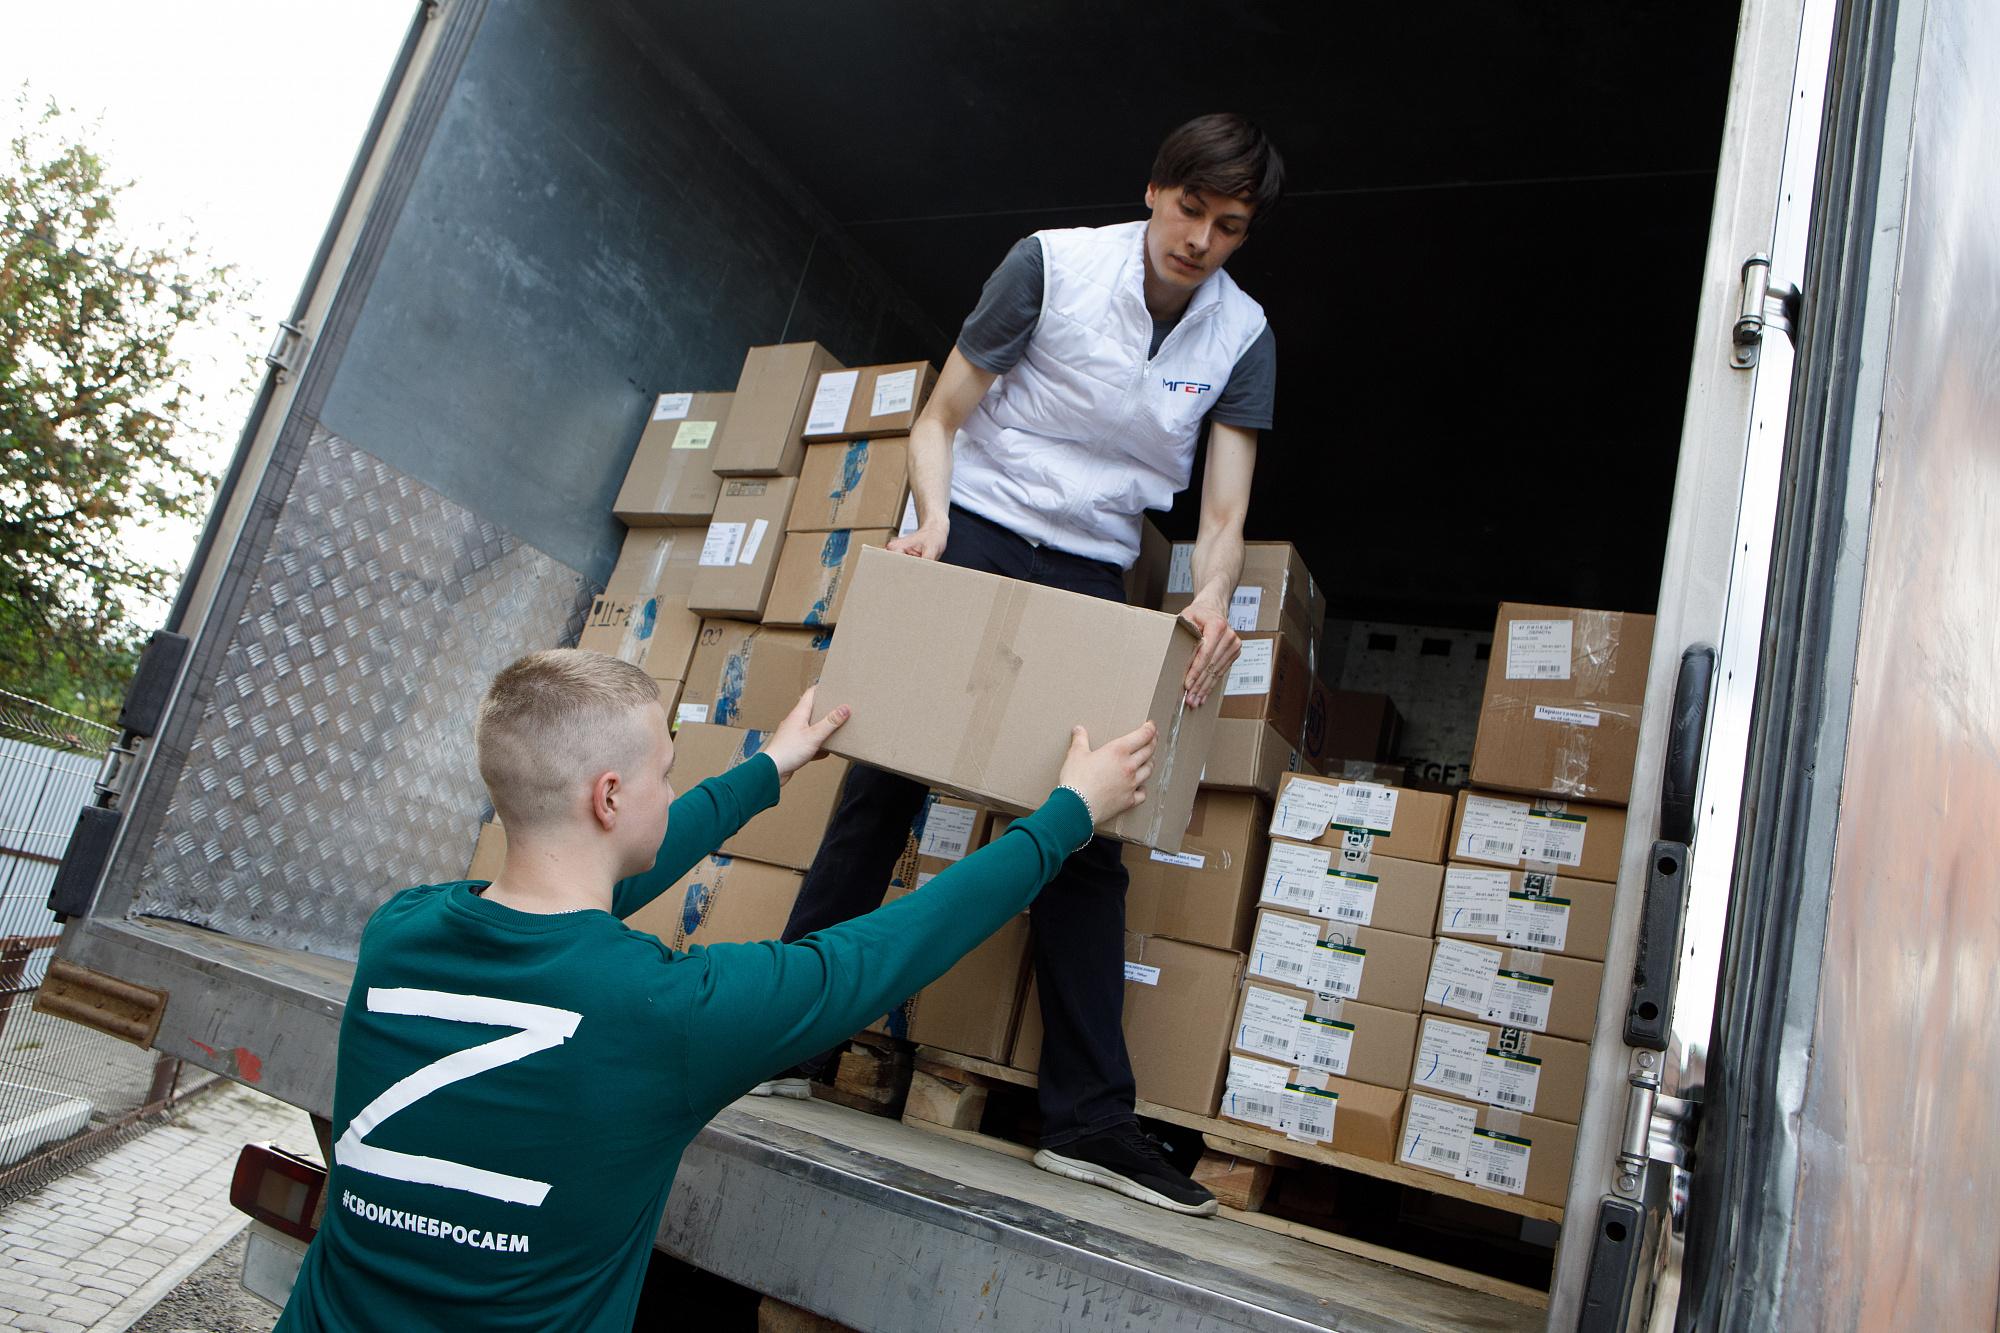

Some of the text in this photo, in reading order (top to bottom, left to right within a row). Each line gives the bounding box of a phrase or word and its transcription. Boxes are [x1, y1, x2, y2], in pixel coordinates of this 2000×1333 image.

[1162, 377, 1211, 394] МГЕР
[334, 987, 584, 1207] Z
[342, 1189, 529, 1253] #СВОИХНЕБРОСАЕМ
